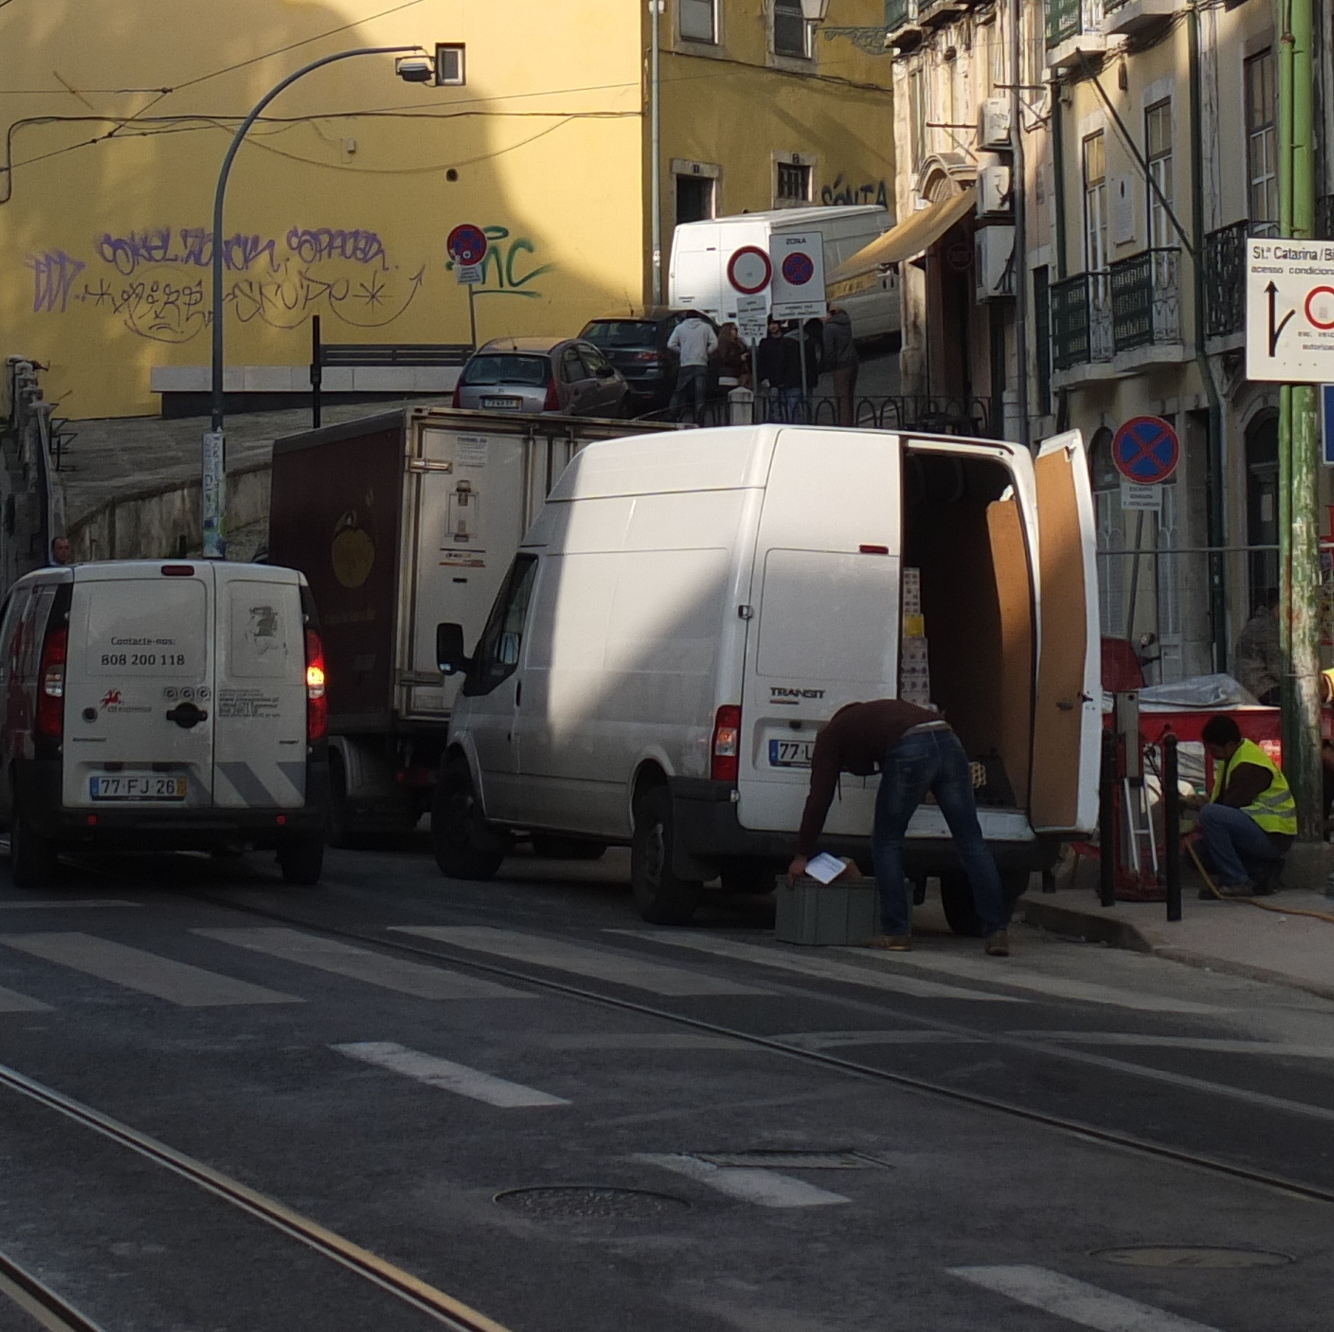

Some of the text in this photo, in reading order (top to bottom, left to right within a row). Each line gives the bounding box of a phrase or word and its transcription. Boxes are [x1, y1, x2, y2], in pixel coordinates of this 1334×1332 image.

[786, 237, 807, 245] ZONA
[1274, 247, 1318, 261] Catarina
[1251, 266, 1284, 274] acesso
[101, 654, 185, 666] 808 200 118
[770, 687, 826, 699] TRANSIT
